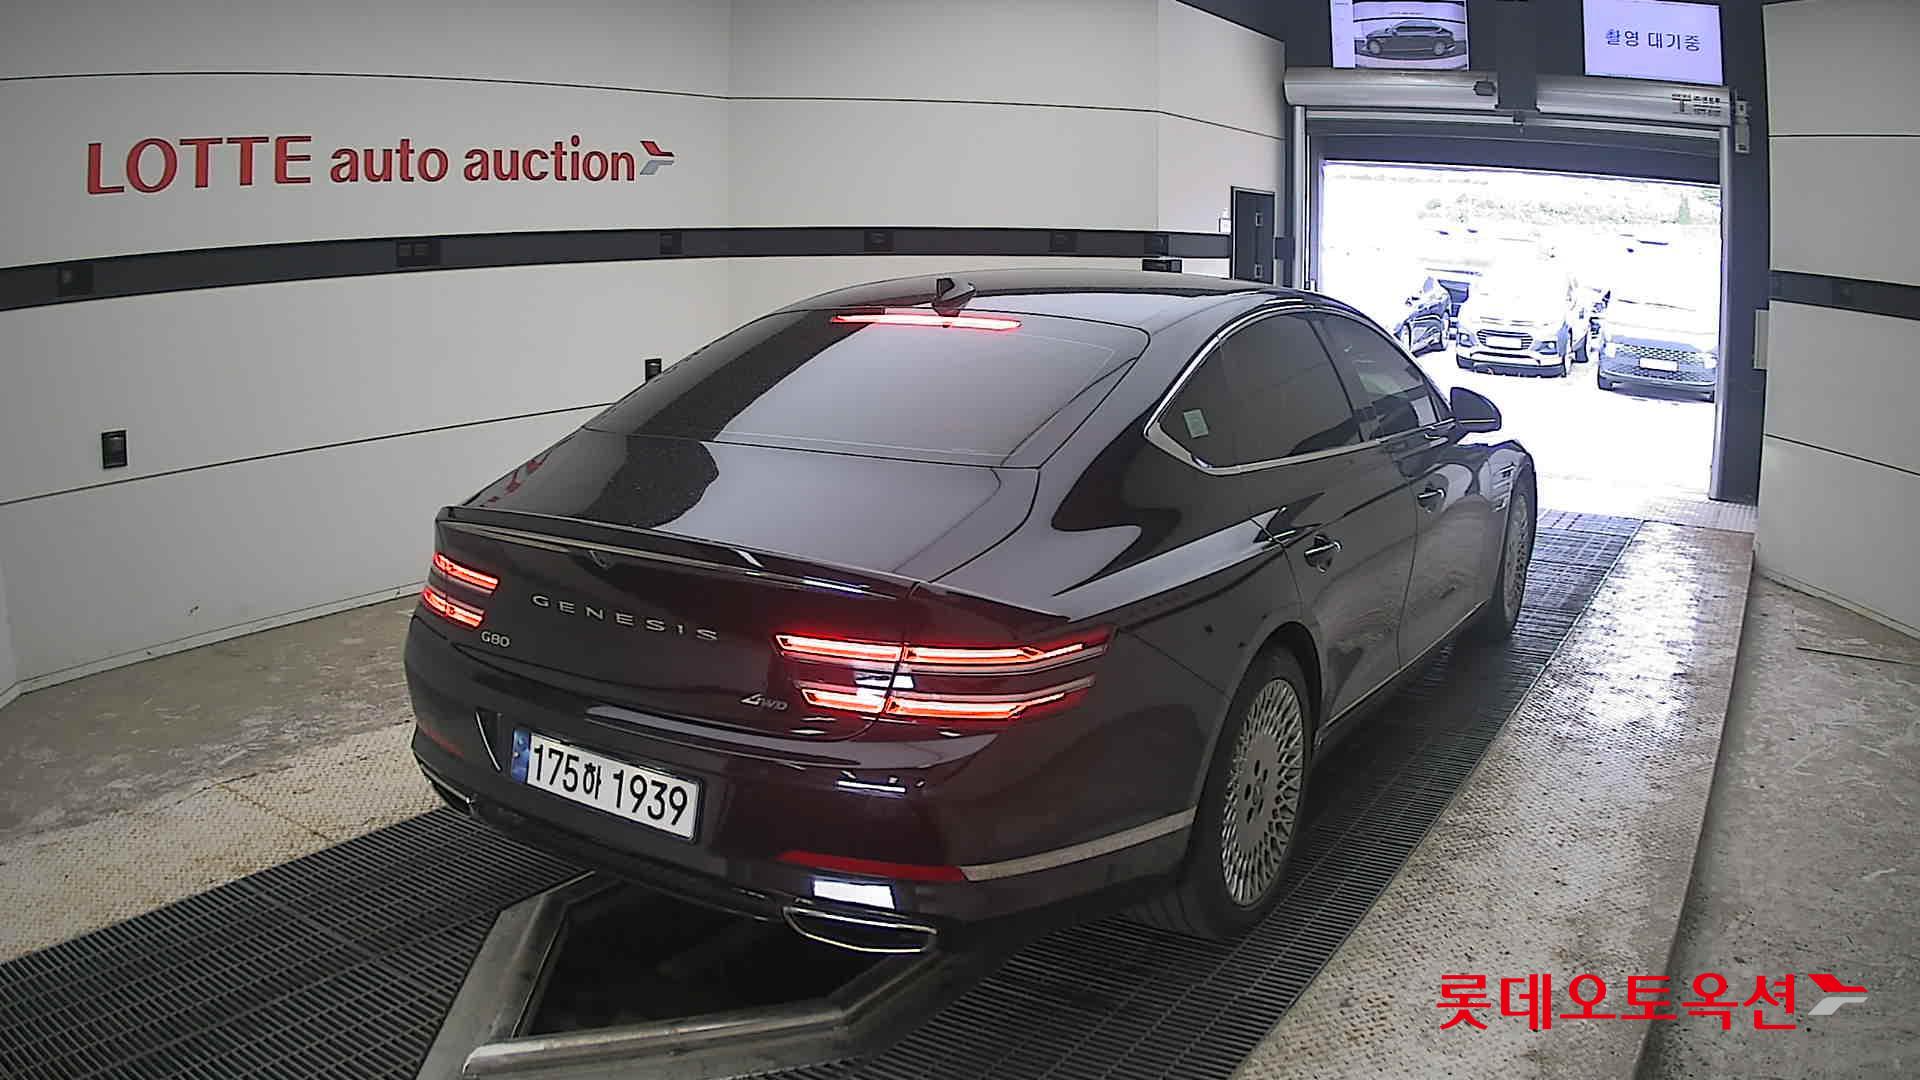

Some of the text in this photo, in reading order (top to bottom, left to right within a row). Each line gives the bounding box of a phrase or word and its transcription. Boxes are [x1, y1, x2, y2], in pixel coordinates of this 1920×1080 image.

[1648, 32, 1700, 51] 대기중
[87, 135, 635, 194] LOTTE auto auction
[532, 595, 718, 640] GENESIS
[481, 631, 510, 647] G80
[741, 693, 788, 710] 4WD
[533, 744, 688, 825] 175하 1939
